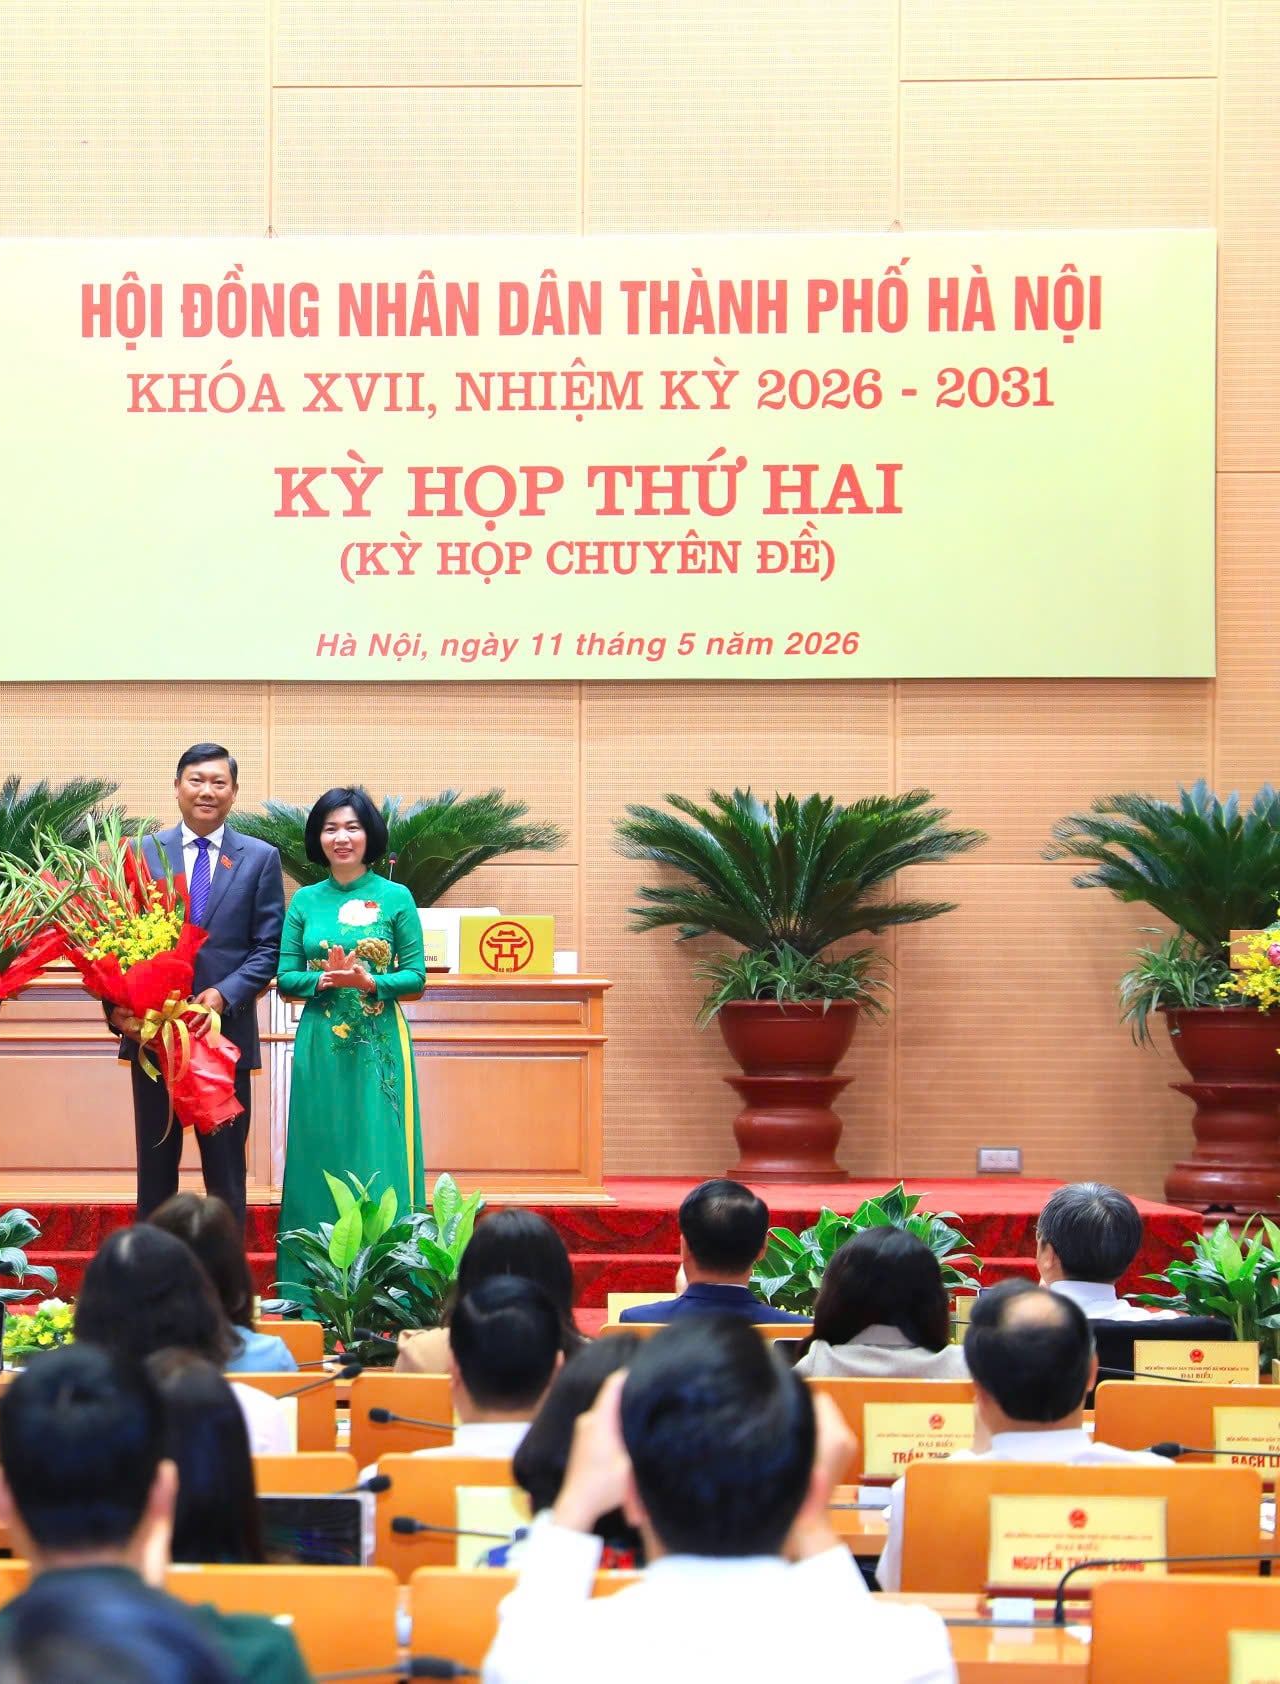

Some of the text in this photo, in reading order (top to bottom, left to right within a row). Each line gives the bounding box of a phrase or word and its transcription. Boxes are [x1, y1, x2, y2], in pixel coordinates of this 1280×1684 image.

[82, 257, 1102, 350] HỘI ĐỒNG NHÂN DÂN THÀNH PHỐ HÀ NỘI
[128, 360, 285, 413] KHÓA
[304, 373, 437, 419] XVII,
[456, 357, 643, 422] NHIỆM
[660, 356, 739, 410] KỲ
[757, 368, 882, 410] 2026
[936, 366, 1054, 408] 2031
[274, 447, 903, 531] KỲ HỌP THỨ HAI
[341, 521, 835, 584] (KỲ HỌP CHUYÊN ĐỀ)
[317, 632, 859, 663] Hà Nội, ngày 11 tháng 5 năm 2026
